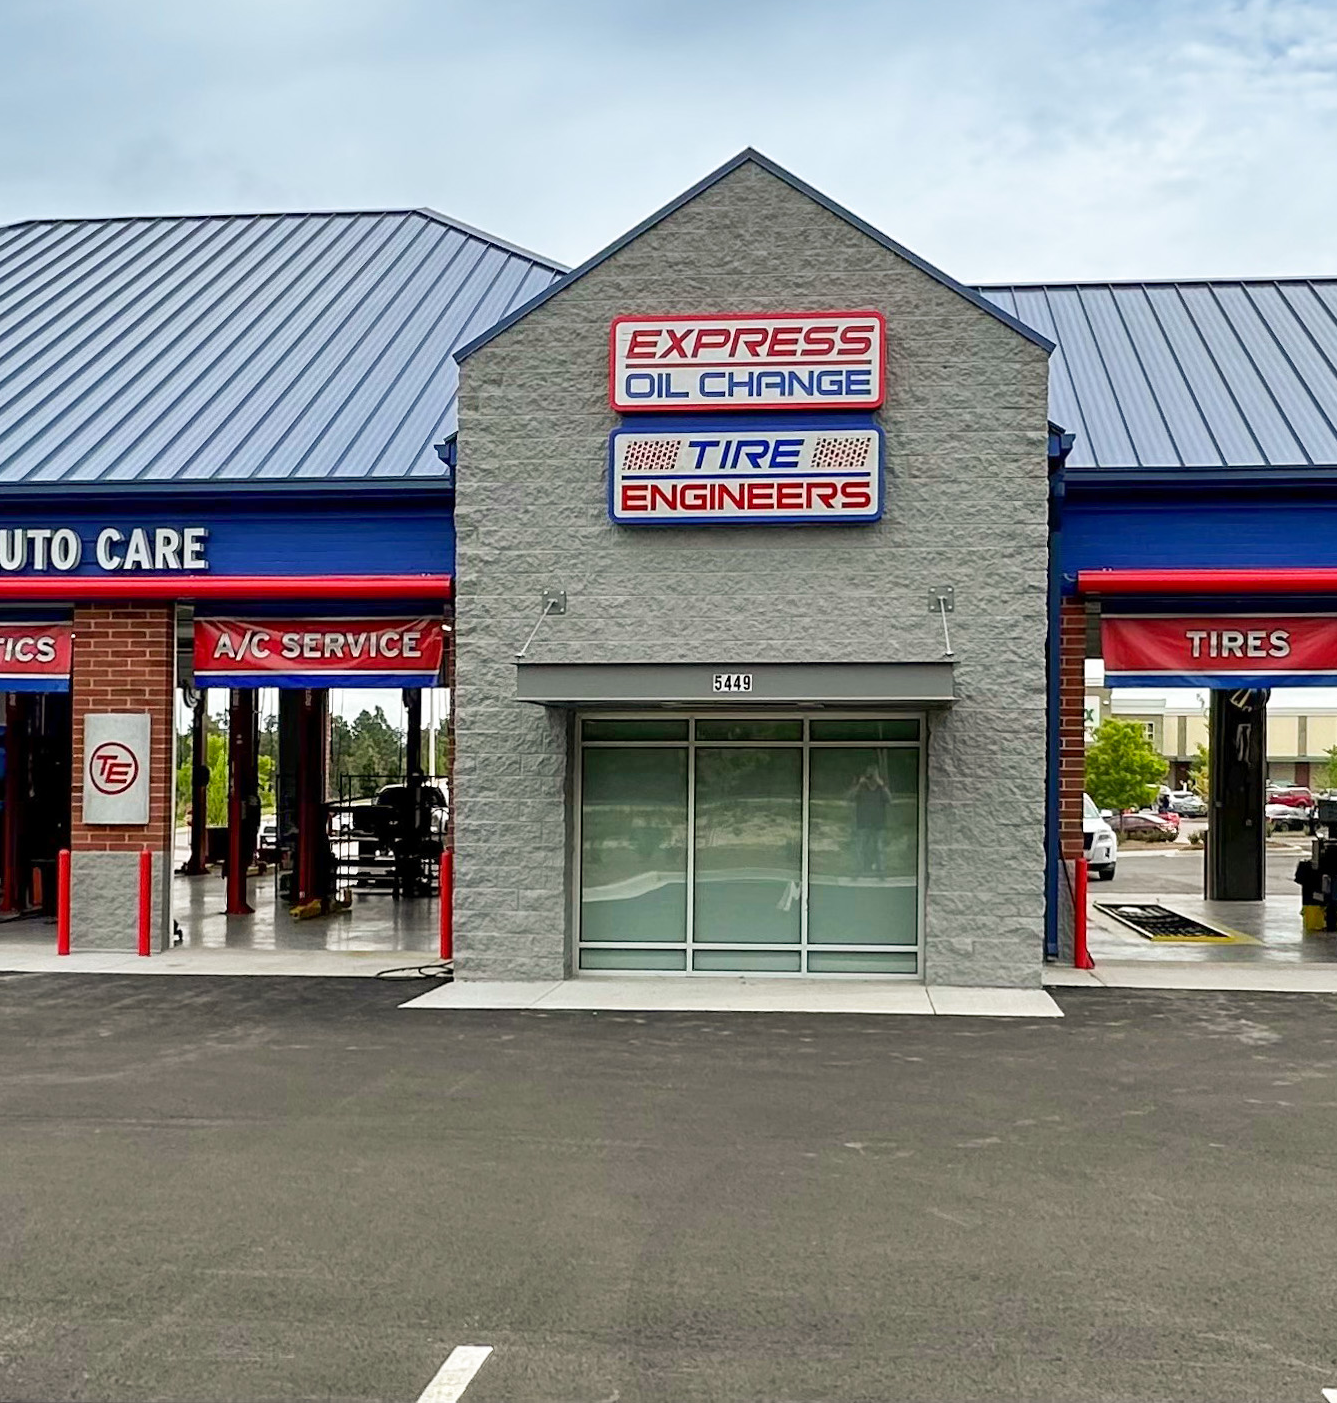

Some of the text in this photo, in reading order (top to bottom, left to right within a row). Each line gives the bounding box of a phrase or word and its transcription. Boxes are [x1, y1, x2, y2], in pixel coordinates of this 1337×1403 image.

[624, 325, 876, 360] EXPRESS
[624, 369, 872, 399] OIL CHANGE
[688, 438, 806, 470] TIRE
[620, 481, 872, 512] ENGINEERS
[95, 527, 209, 571] CARE
[213, 629, 423, 661] A/C SERVICE
[1185, 629, 1291, 658] TIRES
[714, 674, 751, 691] 5449
[96, 754, 133, 784] TE
